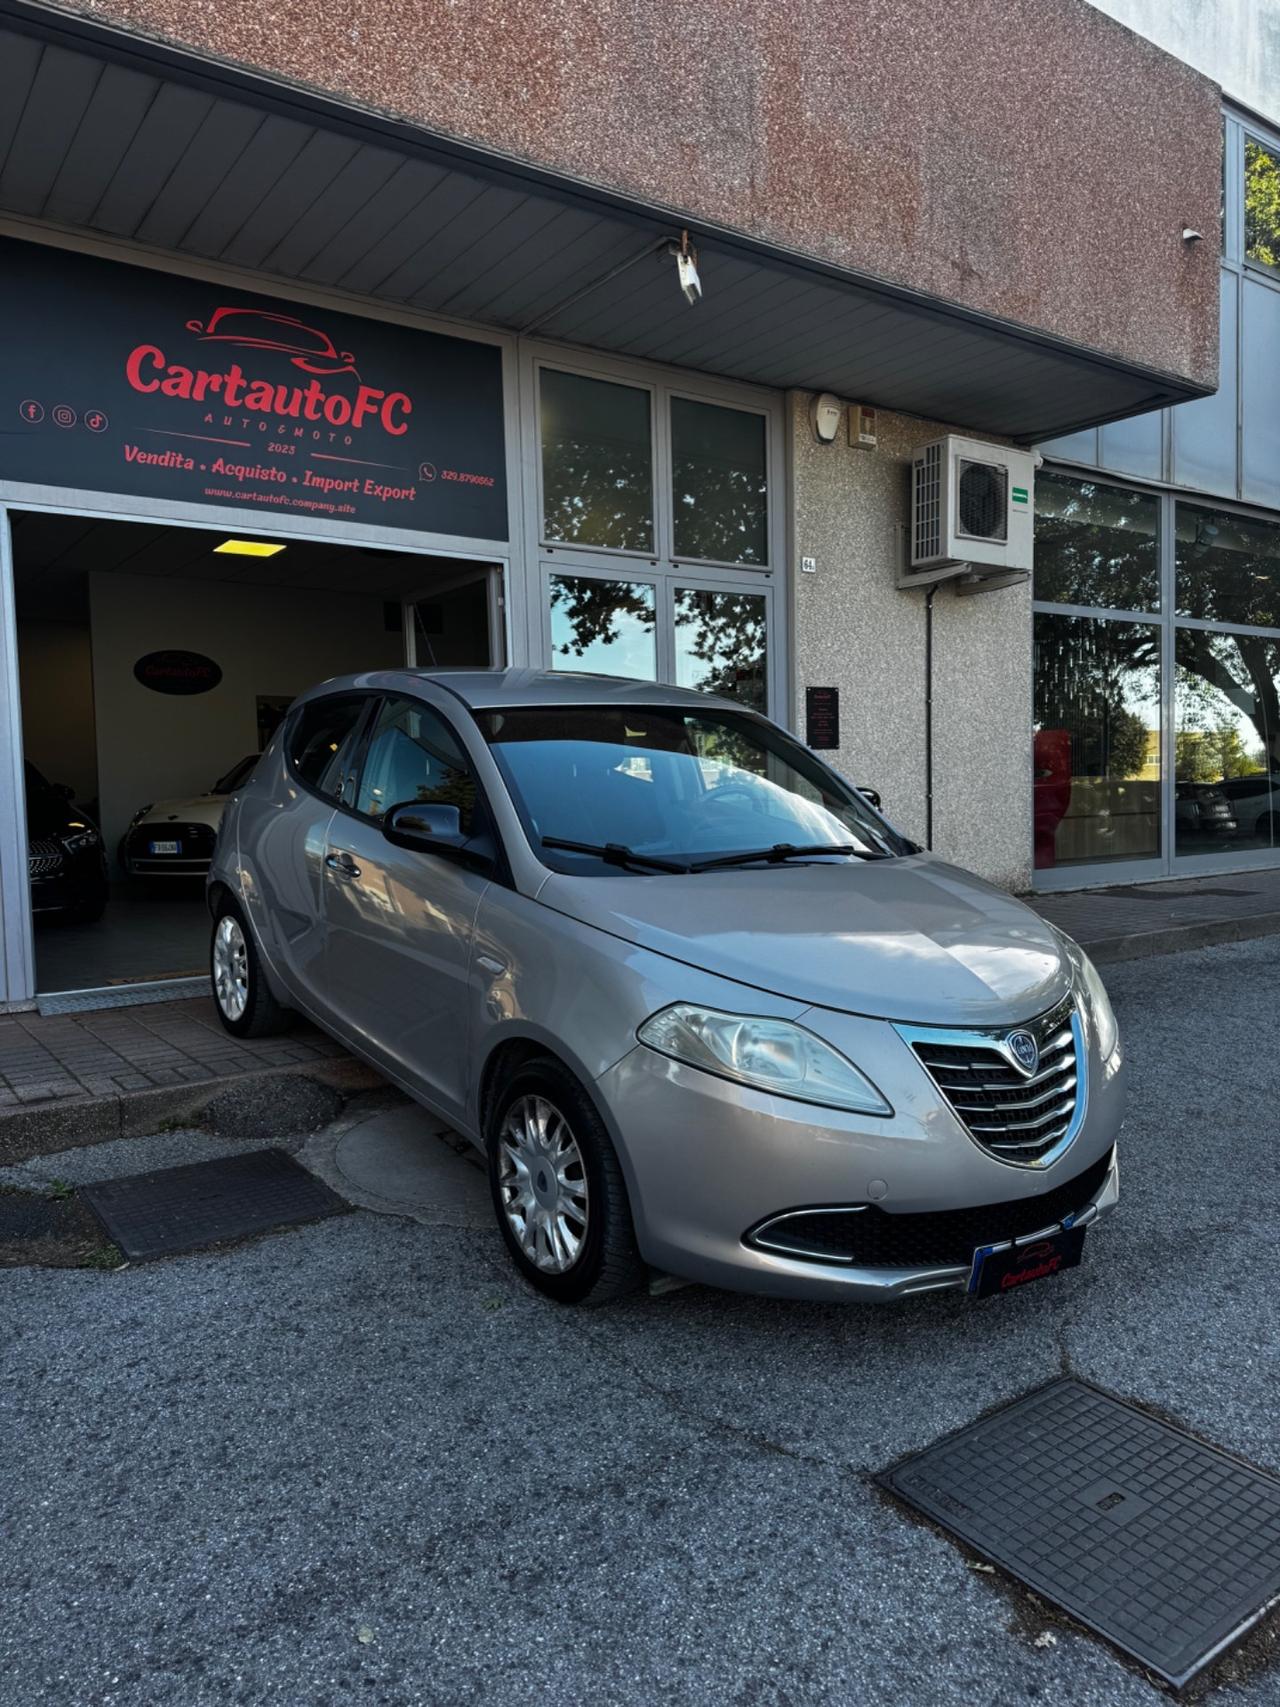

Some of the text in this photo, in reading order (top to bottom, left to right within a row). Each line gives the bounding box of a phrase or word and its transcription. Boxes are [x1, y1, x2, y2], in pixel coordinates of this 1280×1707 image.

[124, 343, 413, 437] CartautoFC
[124, 445, 417, 502] Vendita Acquisto Import Export
[204, 487, 357, 514] www.cartautofc.company.site
